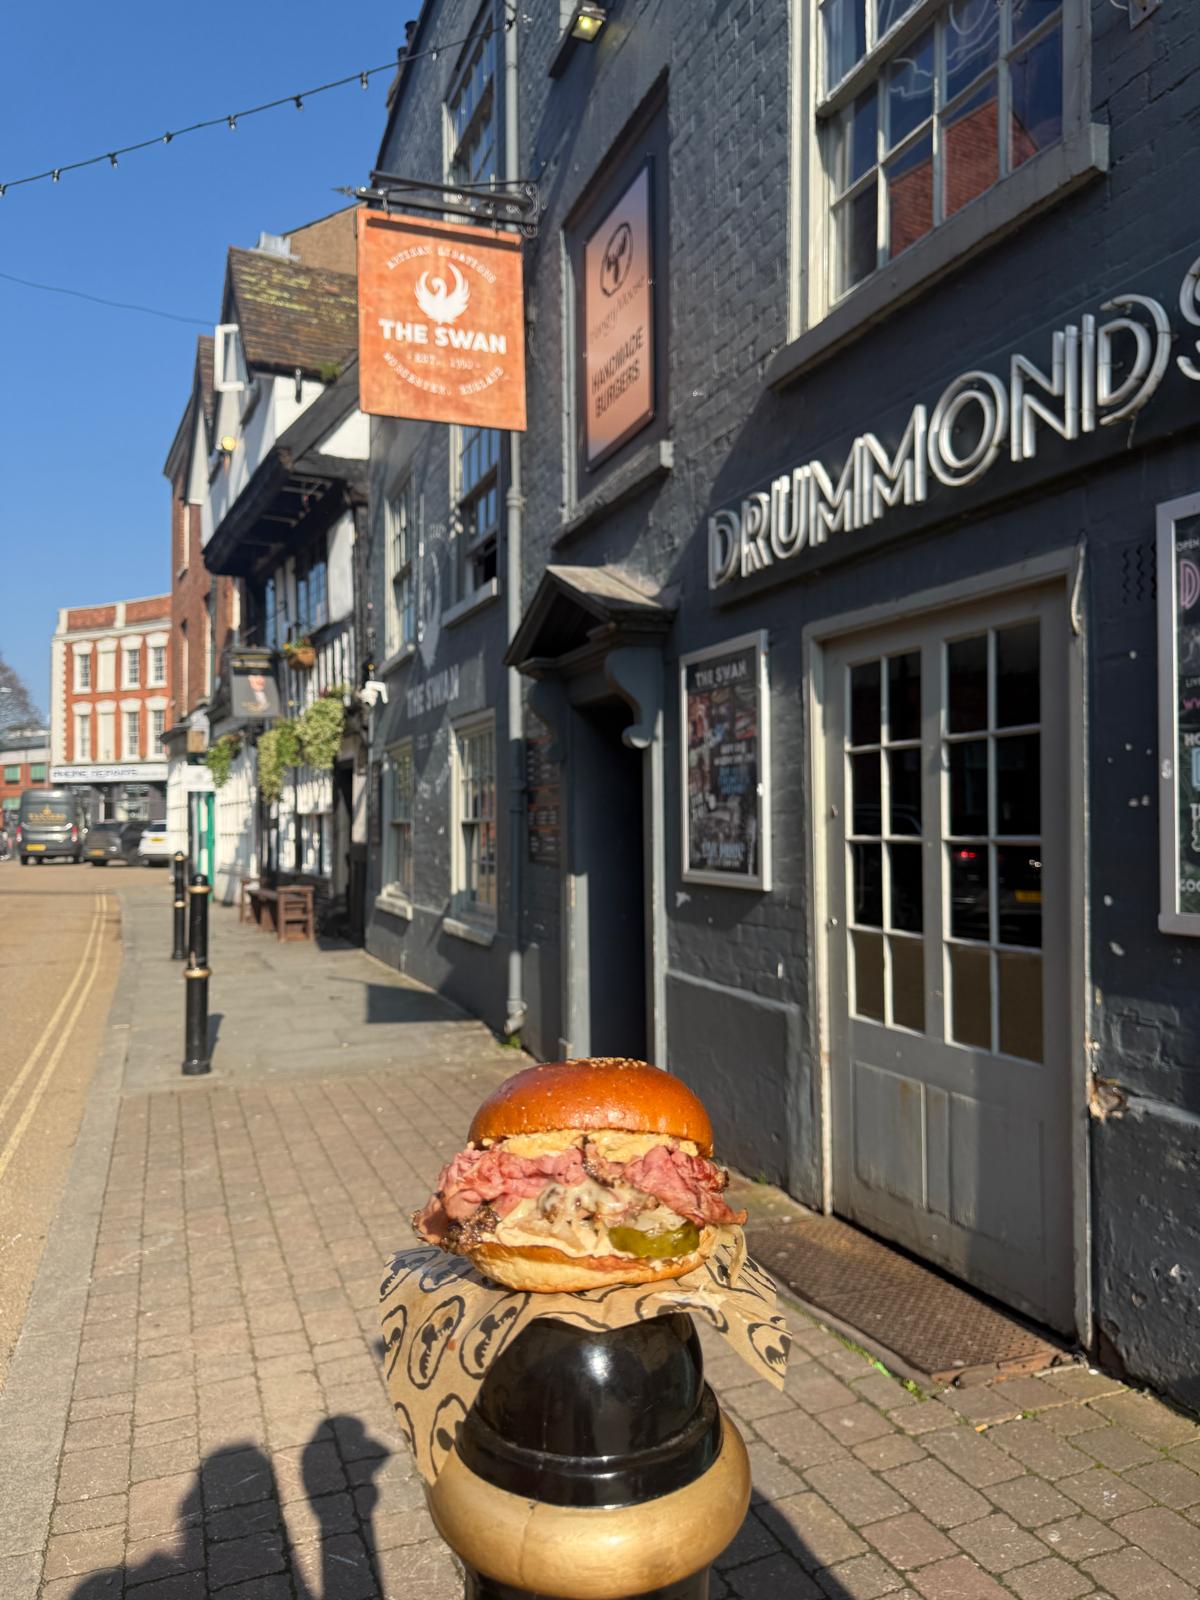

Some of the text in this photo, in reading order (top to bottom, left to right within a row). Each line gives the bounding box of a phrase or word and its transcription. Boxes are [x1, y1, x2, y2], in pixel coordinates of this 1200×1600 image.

[378, 318, 507, 354] THE SWAN
[592, 325, 644, 395] HANDMADE
[595, 358, 640, 420] BURGERS
[694, 659, 747, 688] THE SWAN
